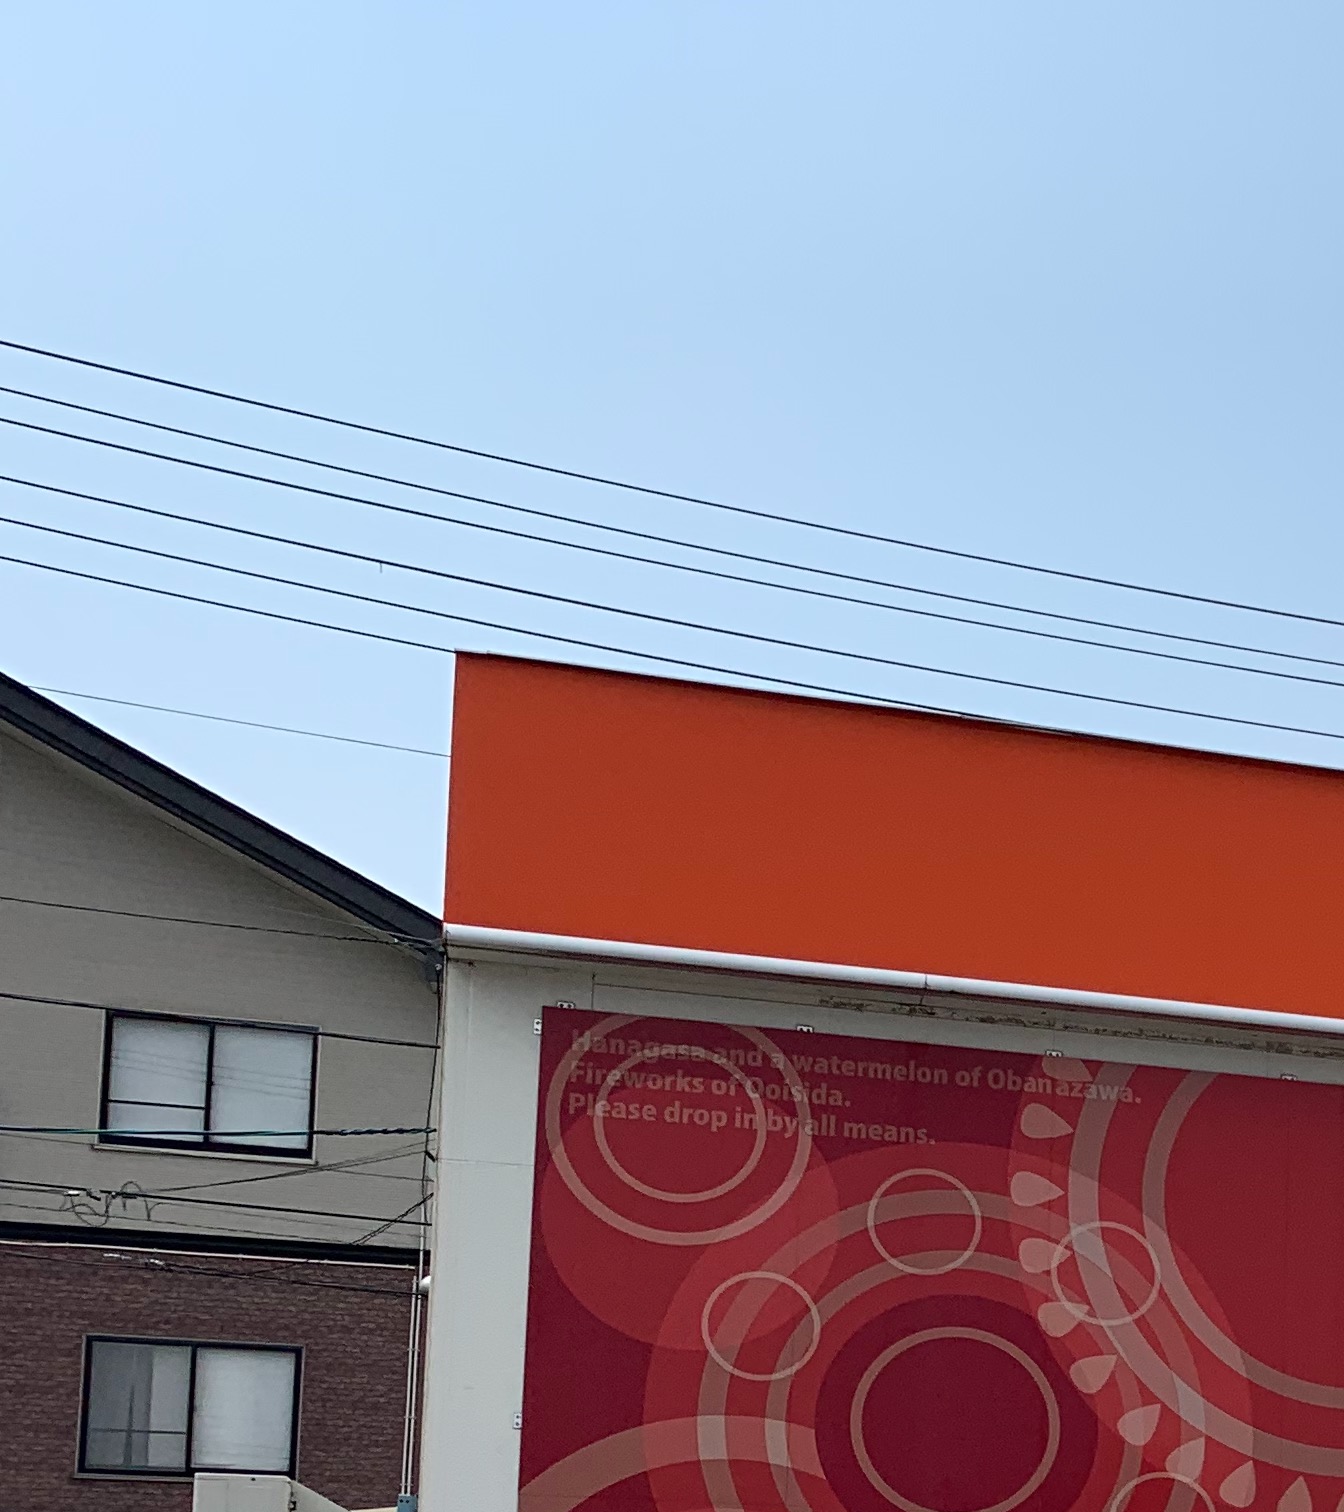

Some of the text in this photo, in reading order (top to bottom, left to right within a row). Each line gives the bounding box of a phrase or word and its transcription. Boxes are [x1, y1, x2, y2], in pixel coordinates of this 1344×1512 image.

[570, 1060, 704, 1093] Fireworks
[711, 1074, 739, 1096] of
[571, 1029, 1142, 1103] Hanagasa and a watermelon of Obanazawa.
[568, 1092, 936, 1145] Please drop in by all means.
